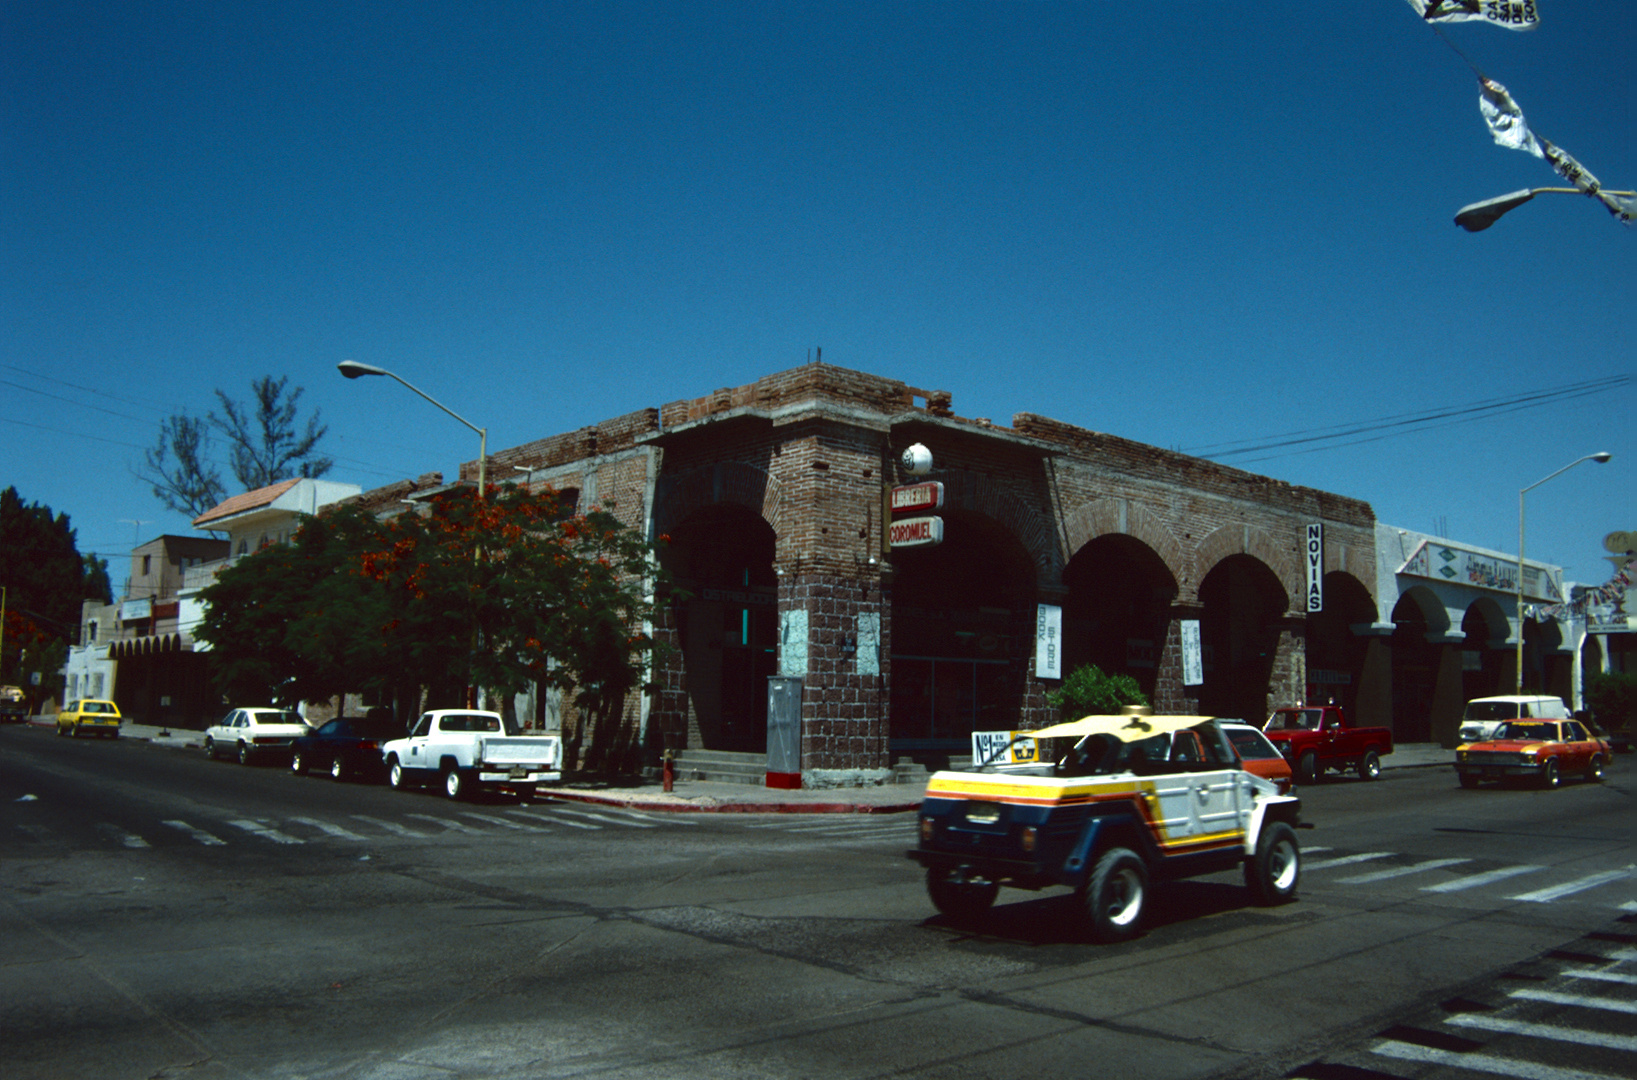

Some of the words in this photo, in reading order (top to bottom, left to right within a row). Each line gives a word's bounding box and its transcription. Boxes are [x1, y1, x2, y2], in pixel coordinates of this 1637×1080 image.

[1512, 3, 1523, 24] DE
[892, 486, 931, 508] LIBRERIA
[890, 521, 932, 543] COROMUEL
[1309, 526, 1320, 609] NOVIAS
[1038, 606, 1046, 641] BOOK
[1047, 626, 1056, 670] STORE
